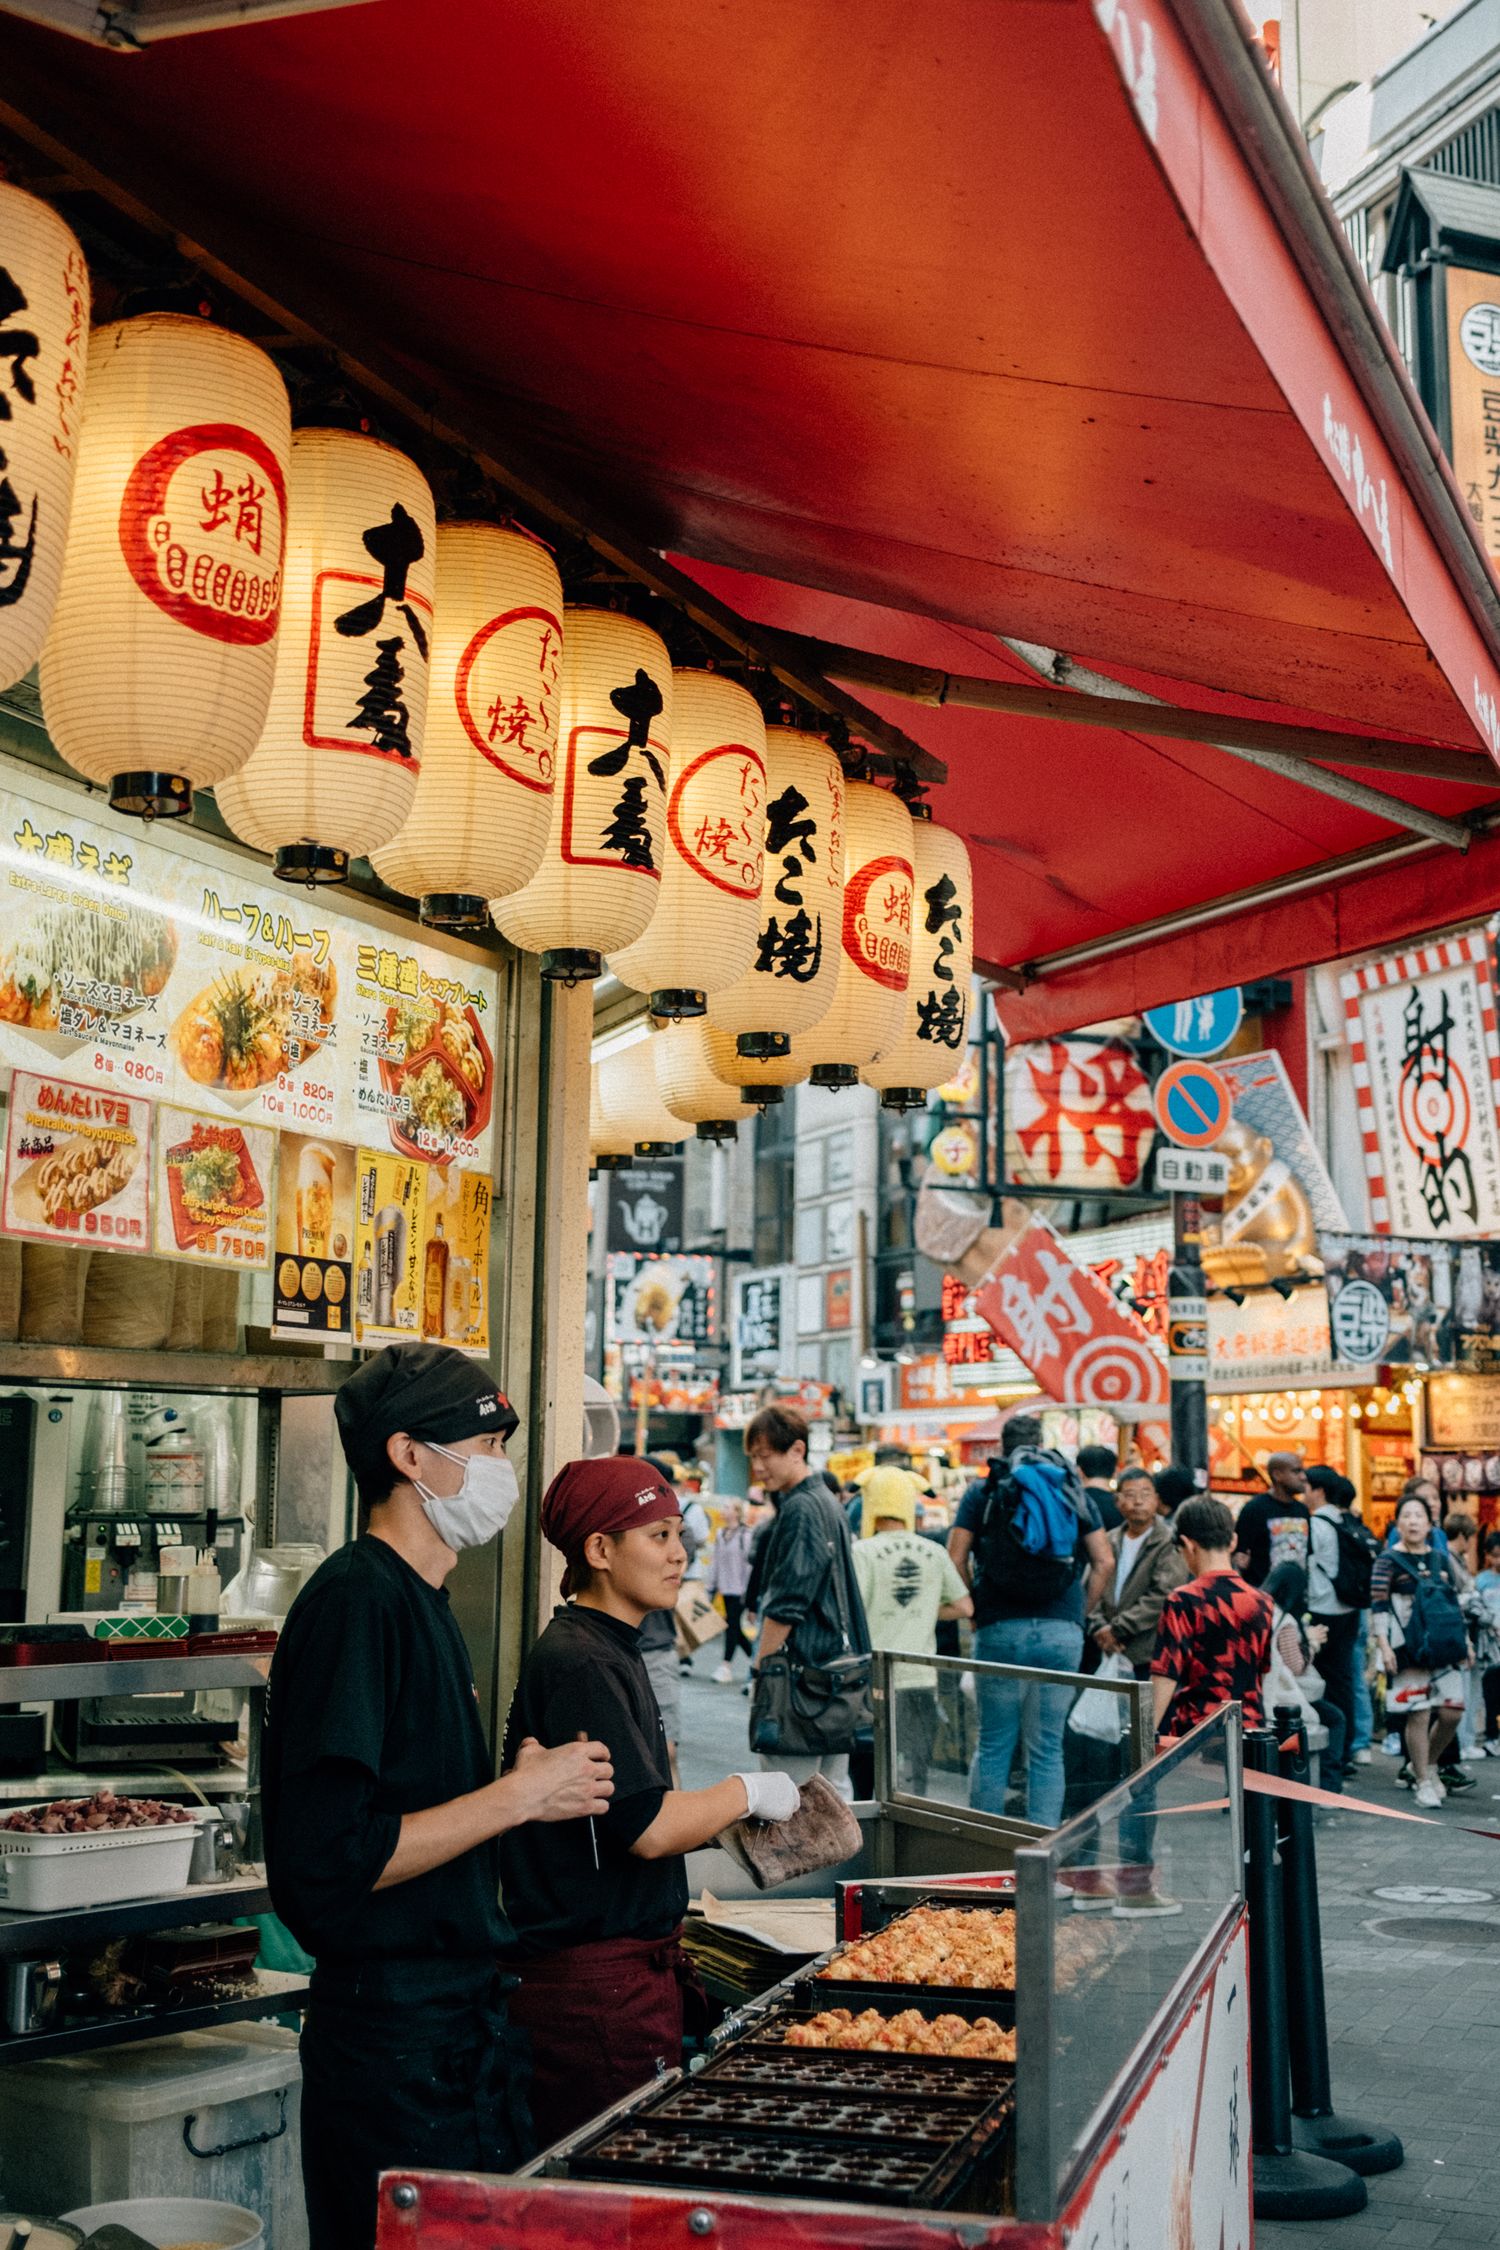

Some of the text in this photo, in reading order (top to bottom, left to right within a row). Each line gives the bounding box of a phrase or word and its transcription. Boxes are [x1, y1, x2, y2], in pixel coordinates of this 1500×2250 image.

[199, 468, 266, 557] 蛸
[9, 871, 129, 922] Extra-Large Green Onion
[754, 784, 823, 984] たこ焼
[883, 884, 912, 935] 蛸
[356, 944, 488, 1013] 三種盛 シェアプレート
[916, 872, 966, 1050] たこ焼
[63, 972, 160, 1013] ソースマヨネーズ
[293, 991, 321, 1013] ソース
[60, 1003, 168, 1050] 塩ダレ&マヨネーズ
[291, 1012, 338, 1038] マヨネーズ
[362, 1012, 388, 1033] ソース
[99, 1036, 136, 1052] Mayonnaise
[361, 1032, 406, 1056] マヨネーズ
[37, 1084, 131, 1128] めんたいマヨ
[358, 1087, 410, 1112] めんたいマヨ
[1402, 984, 1479, 1231] 射的
[18, 1135, 55, 1156] 新商品
[24, 1111, 138, 1147] Mentaiko-Mayonnaise
[1162, 1160, 1224, 1182] 自動車
[221, 1236, 266, 1260] 750円
[301, 1226, 325, 1241] PREMIUM
[472, 1181, 489, 1302] 角ハイボール
[1001, 1250, 1093, 1369] 射
